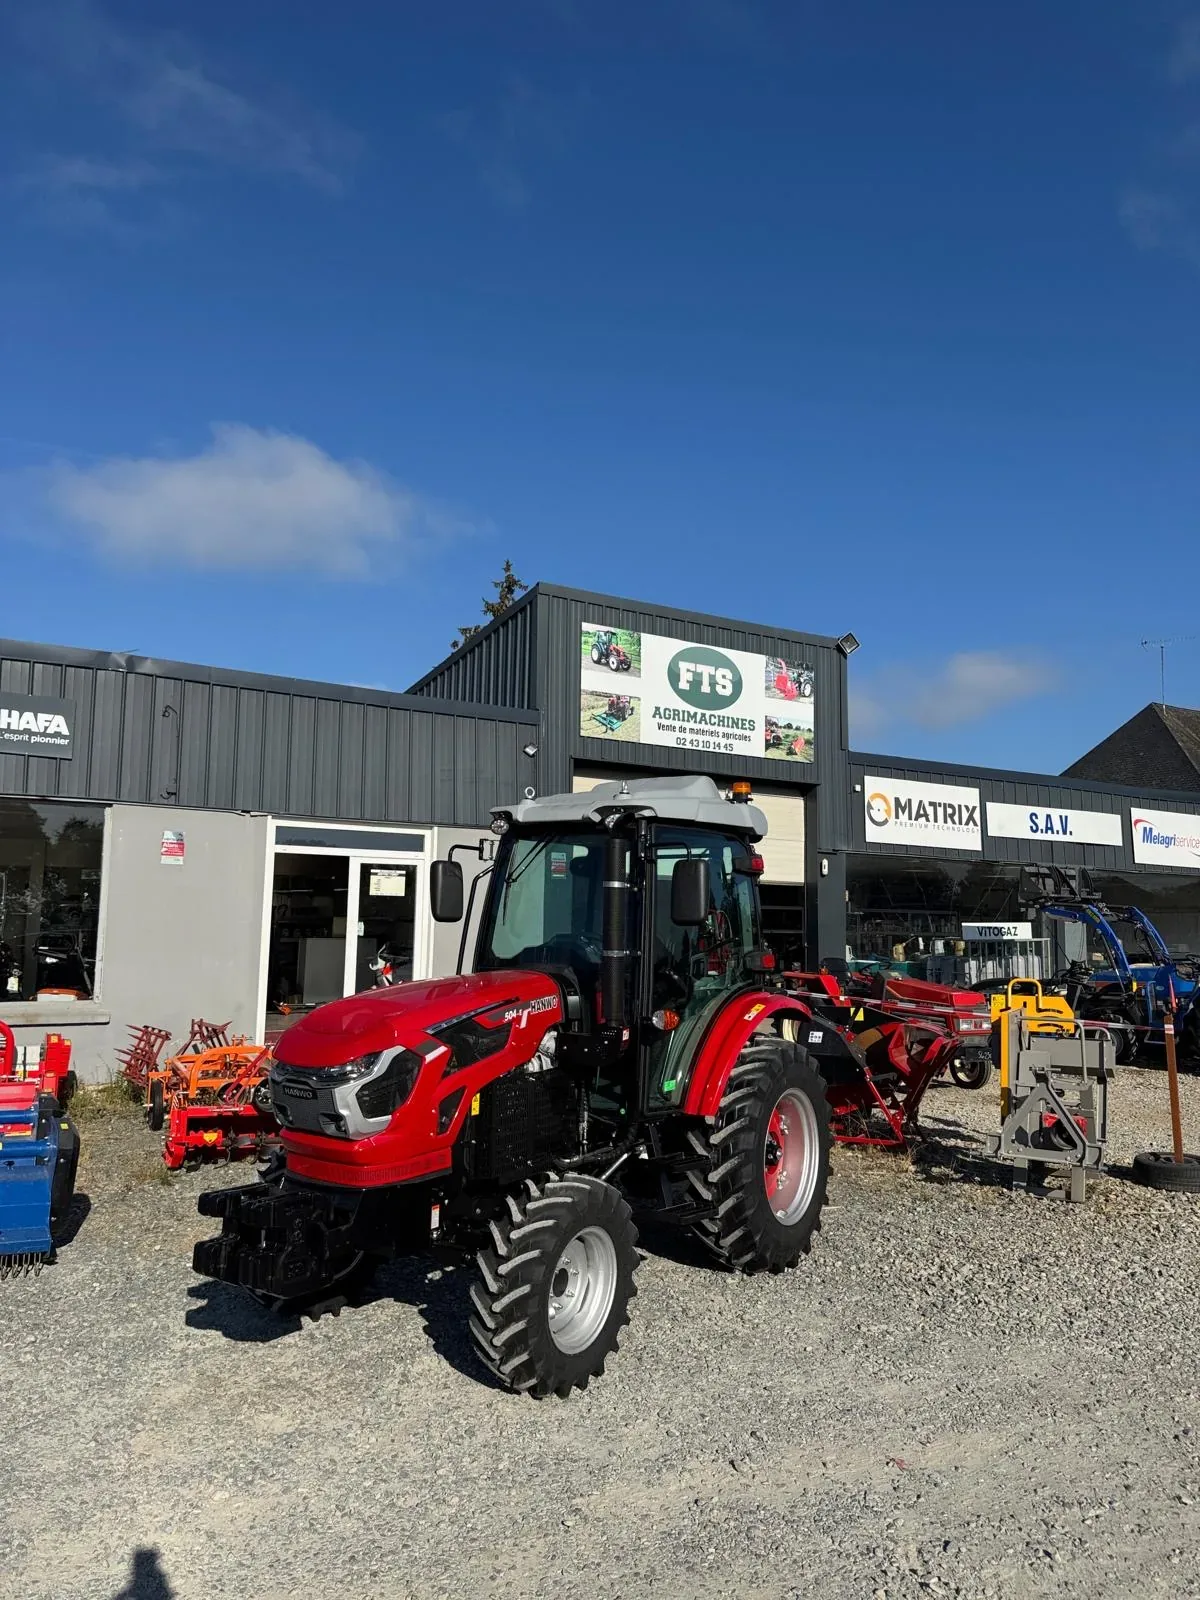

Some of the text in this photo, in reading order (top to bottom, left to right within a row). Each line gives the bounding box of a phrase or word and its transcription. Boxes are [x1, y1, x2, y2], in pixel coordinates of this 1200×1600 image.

[678, 661, 733, 697] FTS
[0, 708, 70, 736] HAFA
[652, 706, 756, 732] AGRIMACHINES
[31, 734, 70, 745] pionnier
[657, 722, 677, 733] Vente
[678, 725, 687, 734] de
[721, 731, 752, 743] agricoles
[676, 737, 734, 752] 02 43 10 14 45
[894, 796, 979, 827] MATRIX
[894, 820, 980, 834] PREMIUM TECHNOLOGY
[1029, 812, 1073, 836] S.A.V.
[529, 995, 558, 1015] HANWO
